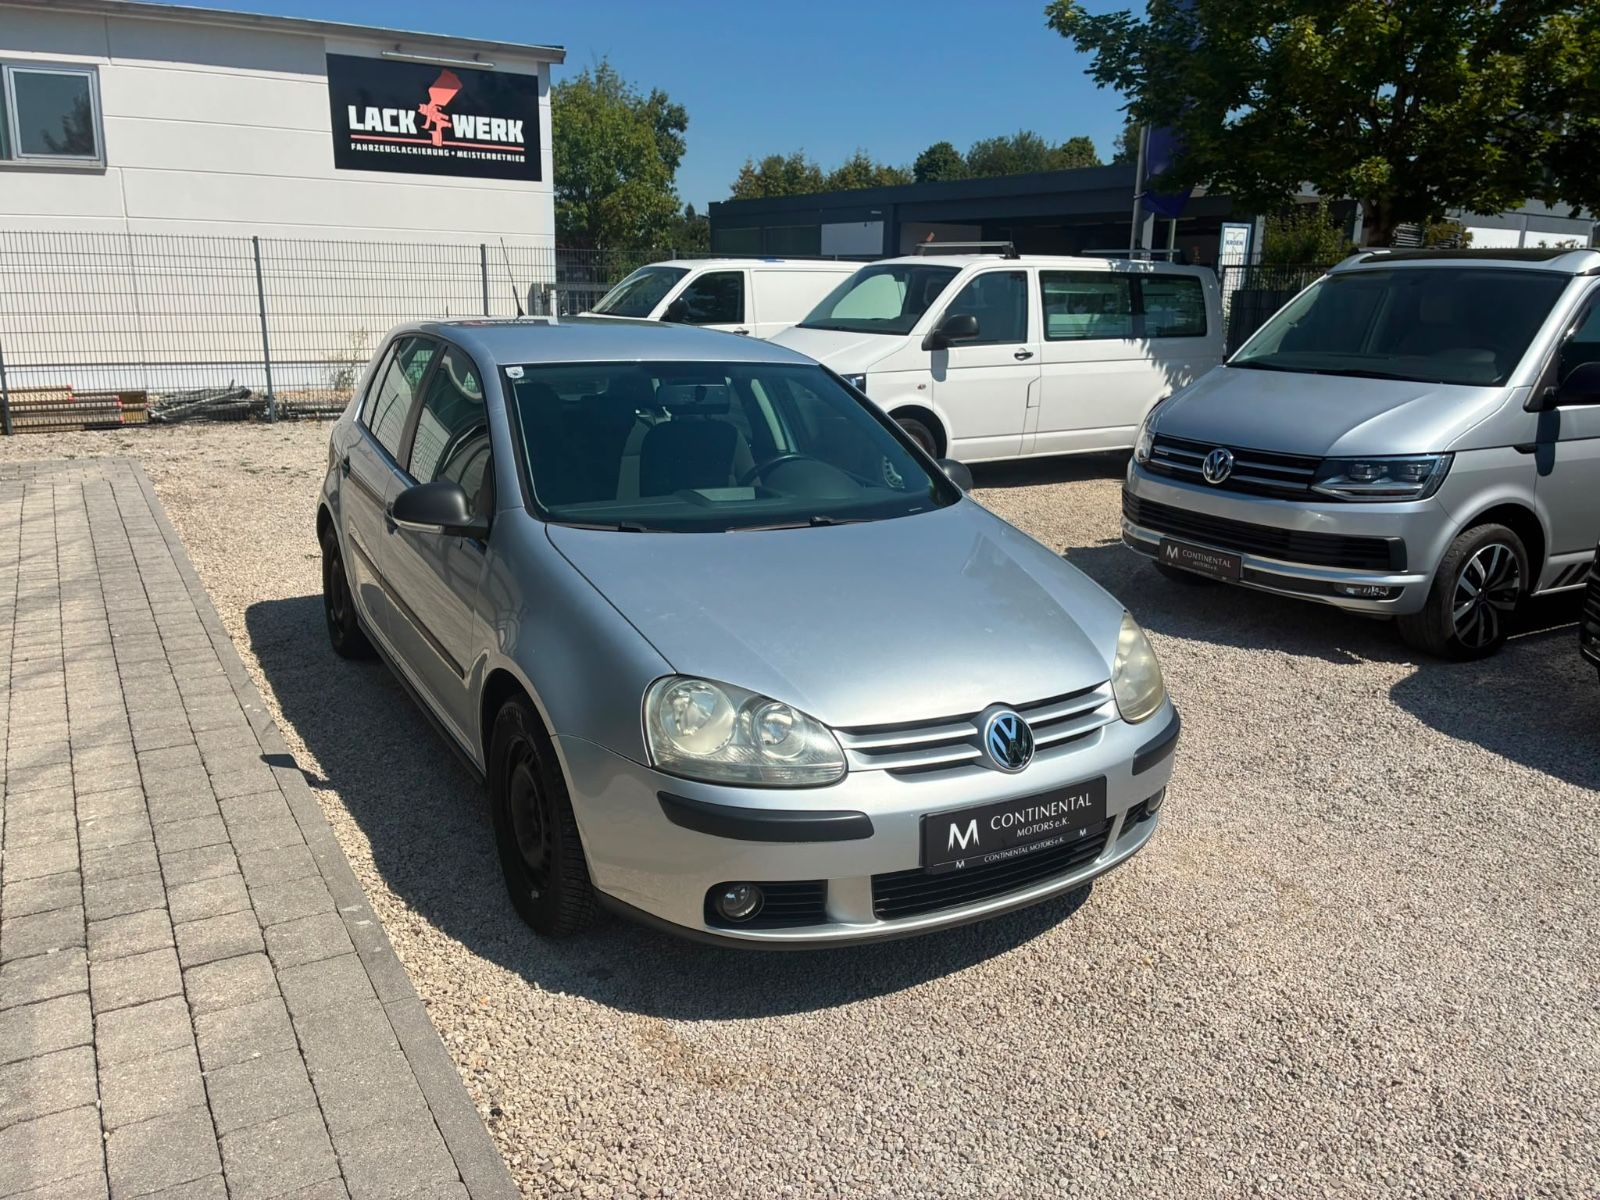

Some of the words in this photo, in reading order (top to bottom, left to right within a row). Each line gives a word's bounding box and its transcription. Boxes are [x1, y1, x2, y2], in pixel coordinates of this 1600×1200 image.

[348, 105, 417, 134] LACK
[451, 113, 524, 143] WERK
[351, 143, 449, 157] FAHRZEUGLACKIERUNG
[457, 151, 525, 163] MEISTERBETRIEB
[1182, 549, 1231, 568] CONTINENTAL
[990, 793, 1092, 830] CONTINENTAL
[948, 819, 980, 851] M
[1016, 820, 1054, 838] MOTORS
[1054, 817, 1071, 828] e.K.
[984, 847, 1028, 862] CONTINENTAL
[1029, 837, 1055, 852] MOTORS
